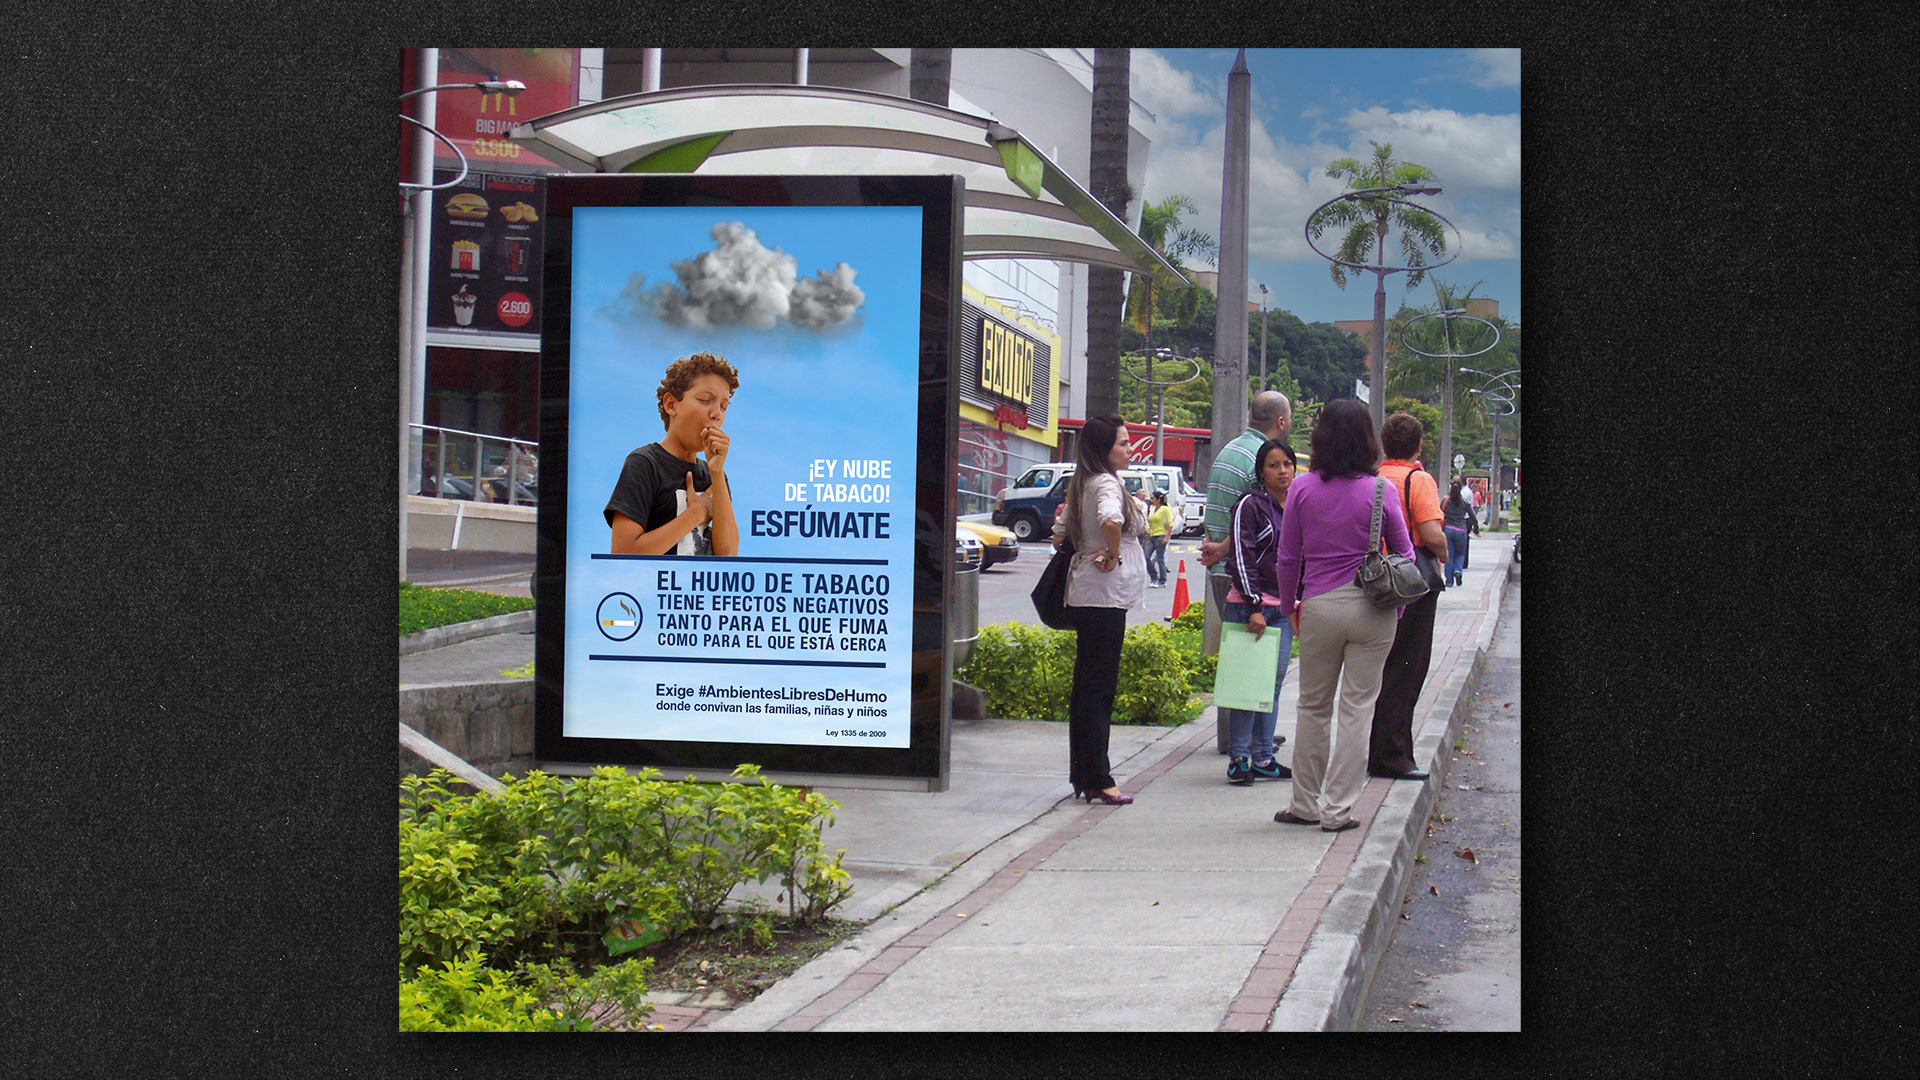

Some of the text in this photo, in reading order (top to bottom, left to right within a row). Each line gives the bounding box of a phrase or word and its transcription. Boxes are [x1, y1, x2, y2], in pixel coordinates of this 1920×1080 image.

[475, 118, 496, 134] BIG
[809, 459, 892, 482] ¡EY NUBE
[784, 482, 890, 504] DE TABACO!
[751, 504, 891, 539] ESFÚMATE
[657, 570, 890, 596] EL HUMO DE TABACO
[657, 594, 889, 615] TIENE EFECTOS NEGATIVOS
[657, 613, 888, 635] TANTO PARA EL QUE FUMA
[657, 632, 887, 652] COMO PARA EL QUE ESTÁ CERCA
[656, 683, 888, 703] Exige #AmbientesLibresDeHumo
[656, 700, 888, 719] donde convivan las familias, niñas y niños
[825, 729, 839, 738] Ley
[840, 729, 857, 737] 1335
[868, 730, 887, 738] 2009
